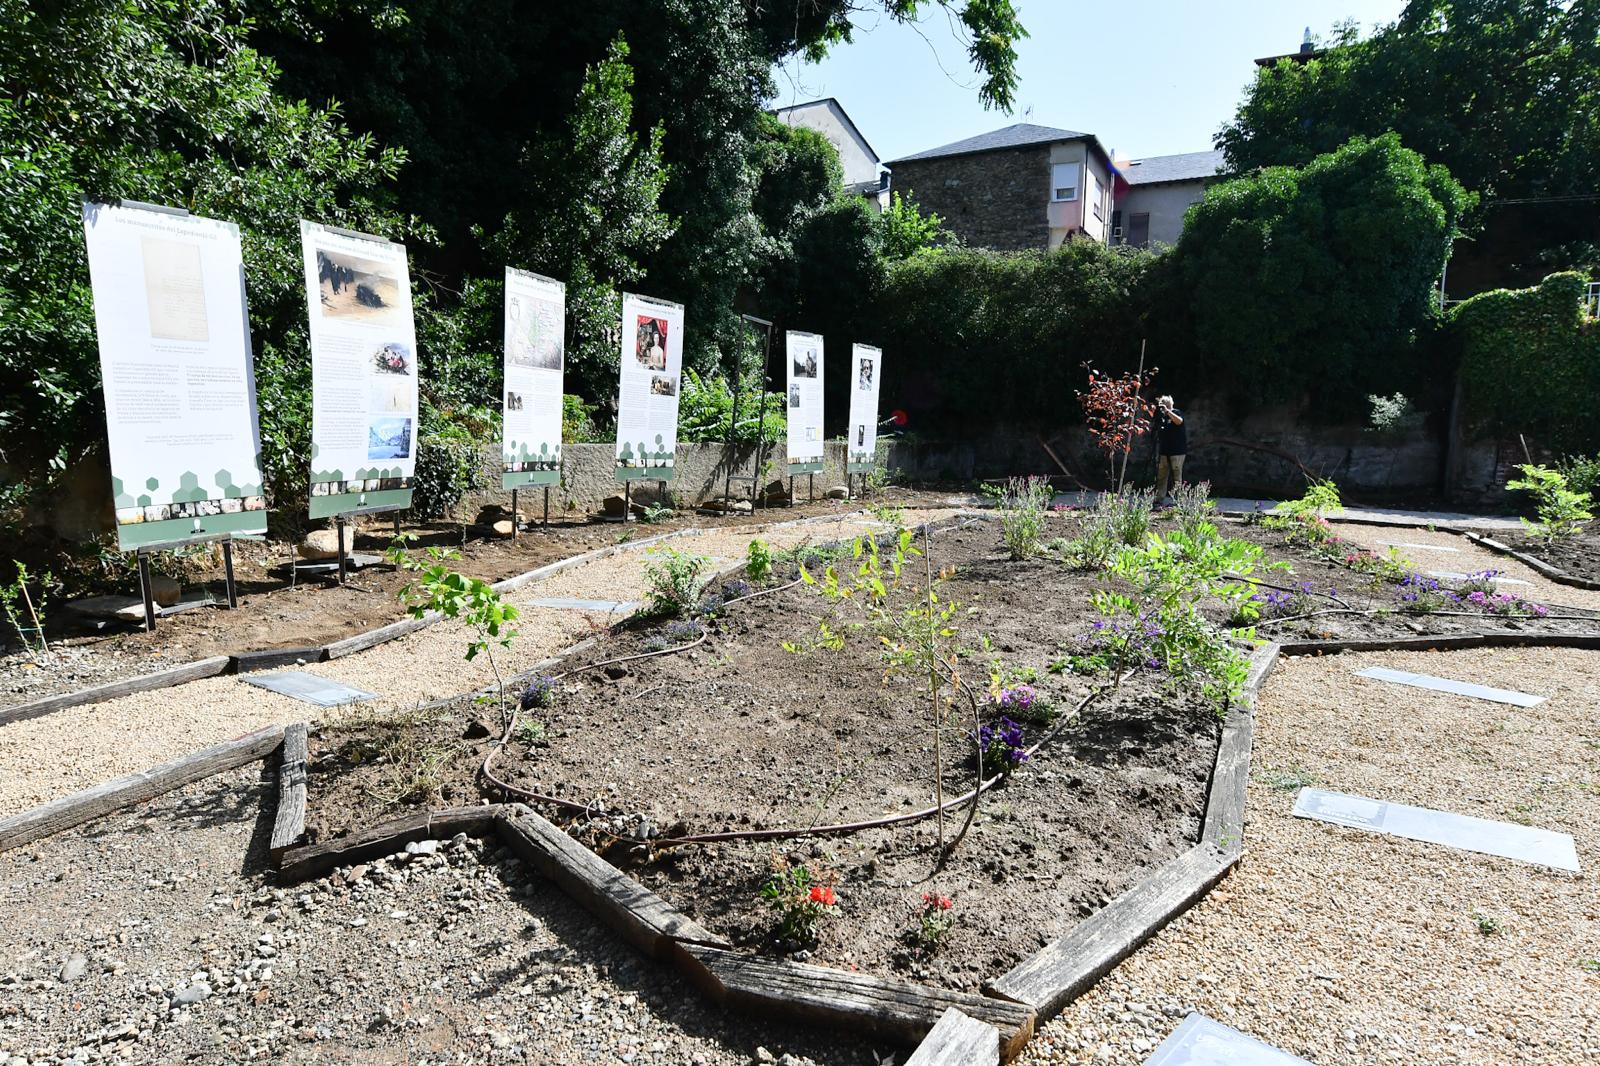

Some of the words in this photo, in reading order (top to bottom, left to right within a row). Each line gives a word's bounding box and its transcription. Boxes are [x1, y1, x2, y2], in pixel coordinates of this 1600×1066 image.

[115, 215, 126, 225] Los
[127, 217, 165, 232] manuscritos
[166, 223, 176, 233] del
